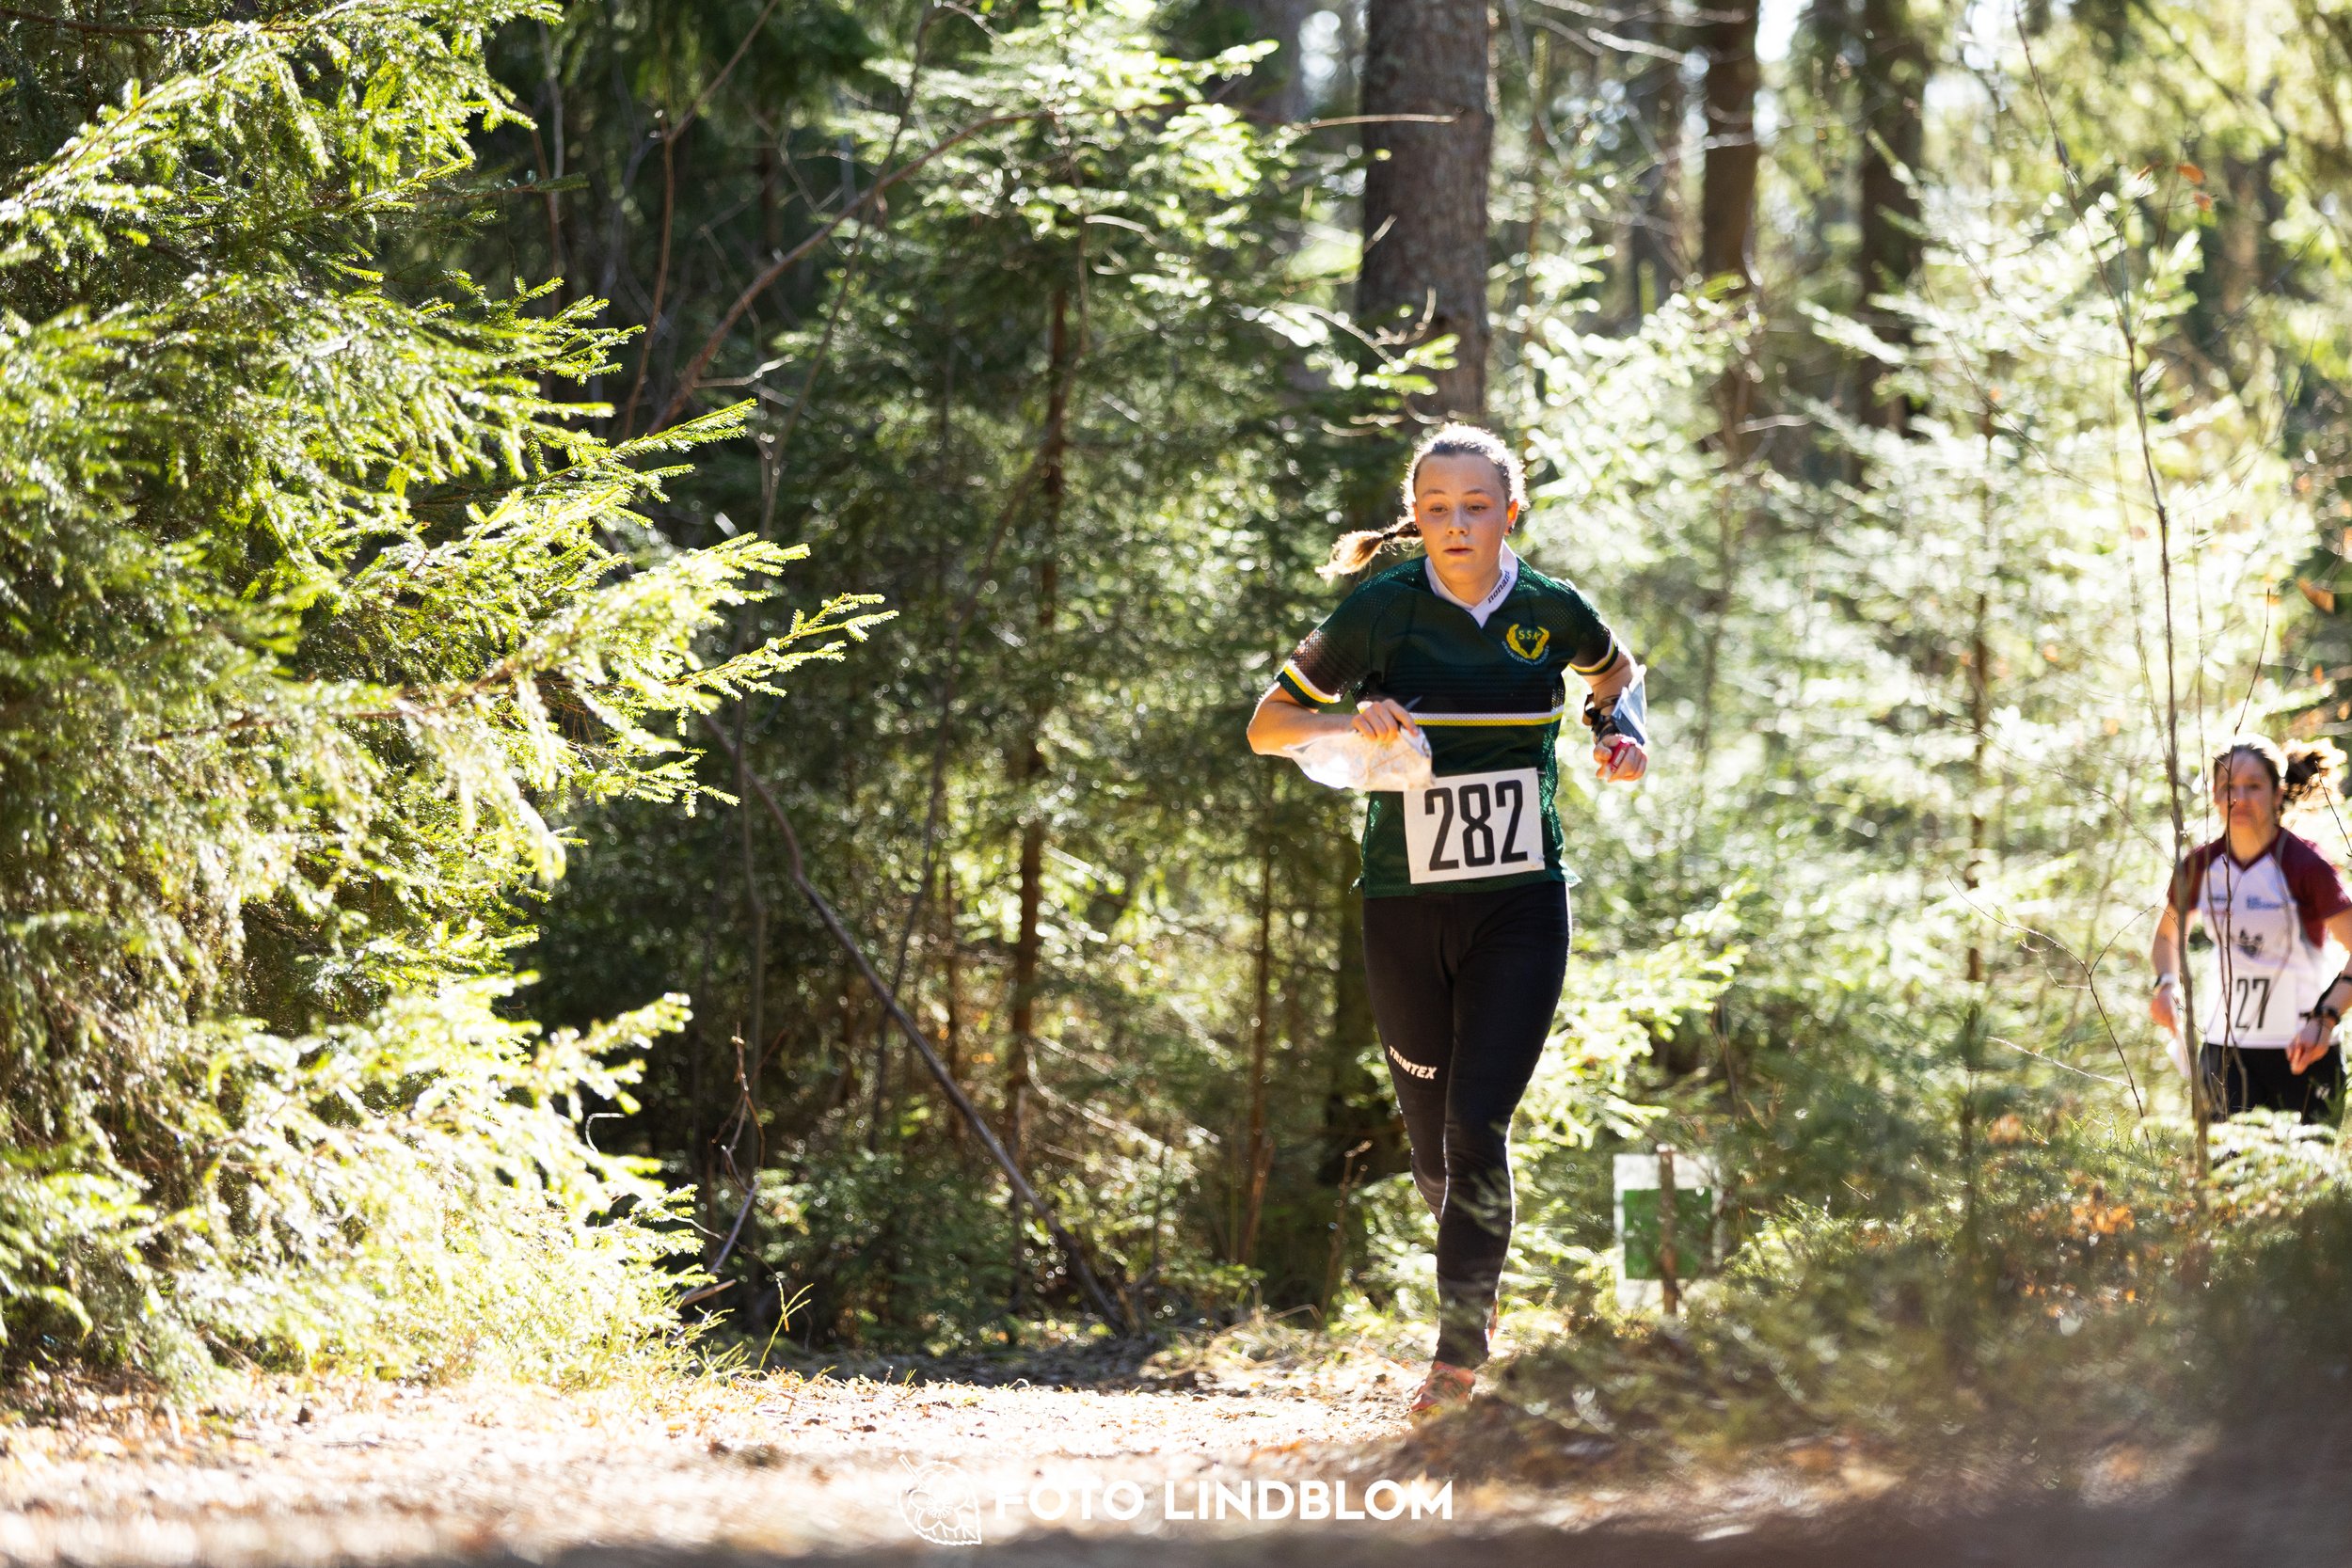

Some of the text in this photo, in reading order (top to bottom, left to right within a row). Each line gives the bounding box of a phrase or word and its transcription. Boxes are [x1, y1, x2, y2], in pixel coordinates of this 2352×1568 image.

[1518, 630, 1542, 641] SSK
[1423, 779, 1529, 871] 282
[2234, 977, 2270, 1030] 27
[1389, 1045, 1438, 1080] TRIMTEX
